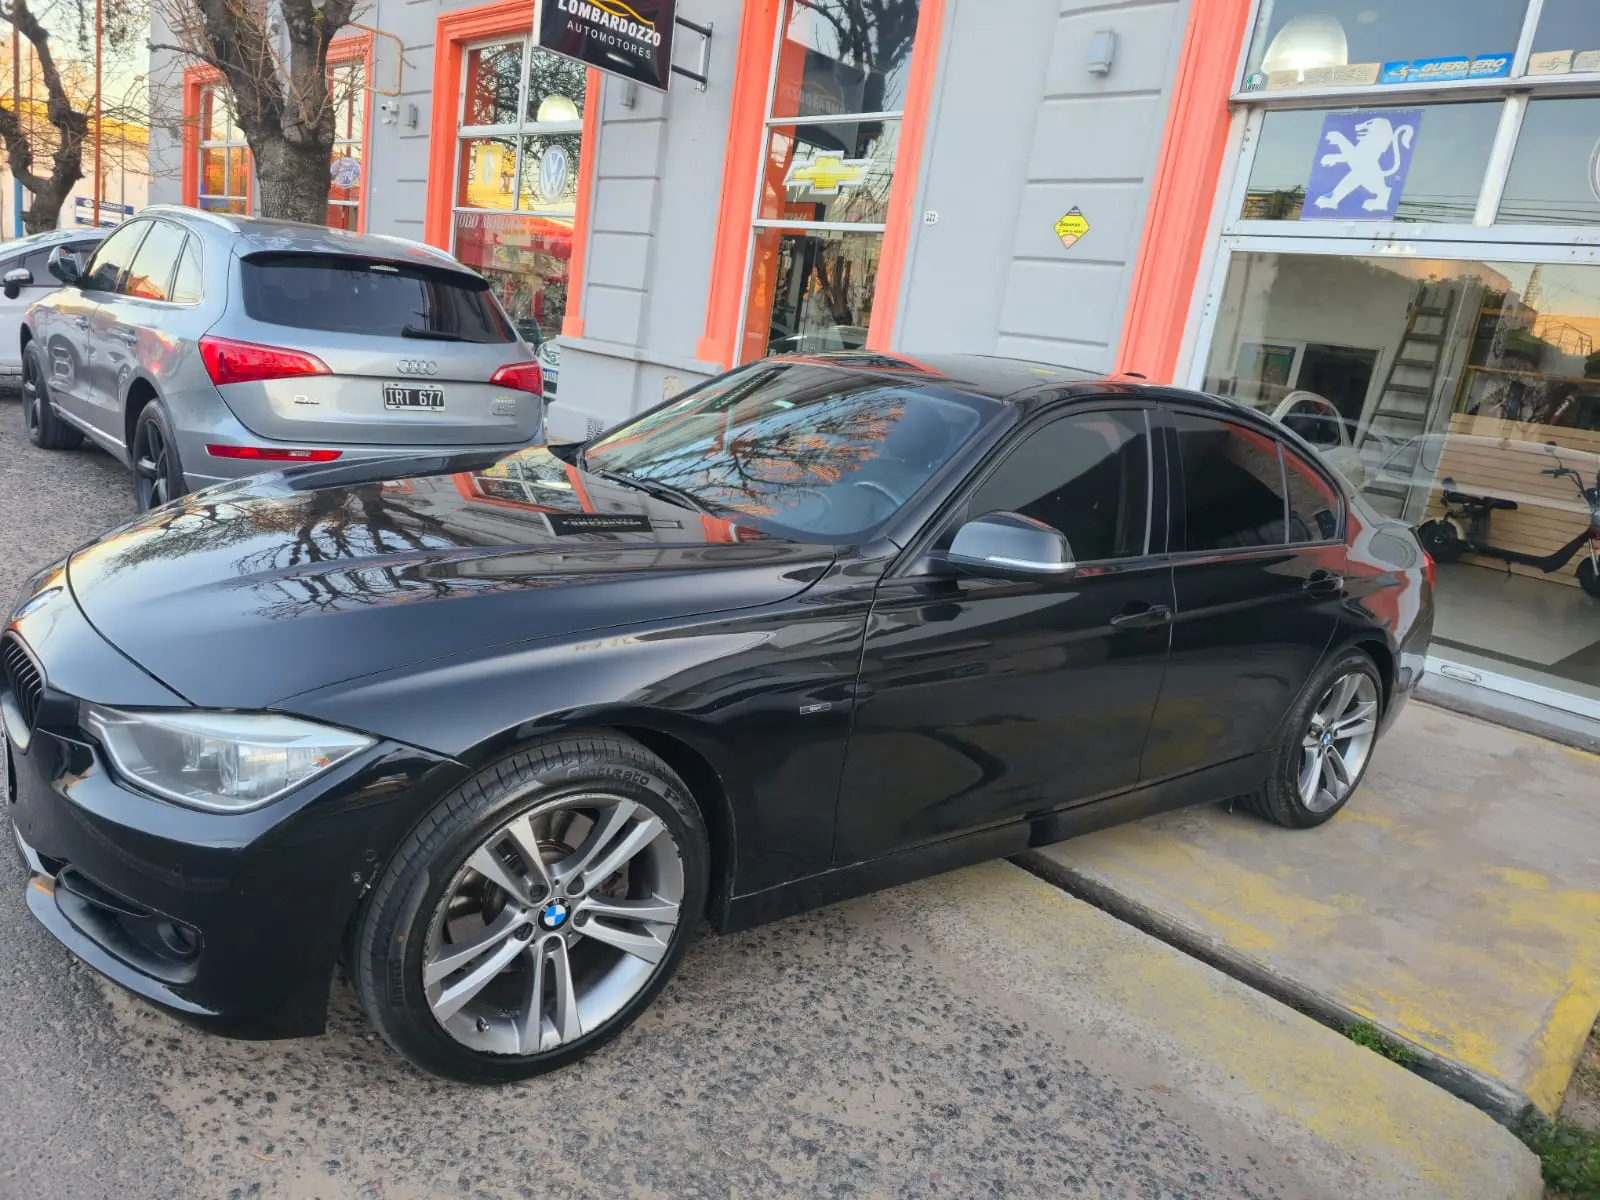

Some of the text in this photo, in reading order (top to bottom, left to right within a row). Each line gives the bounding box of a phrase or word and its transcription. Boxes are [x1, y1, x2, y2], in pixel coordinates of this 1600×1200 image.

[557, 0, 662, 47] LOMBARDOZZO
[566, 19, 652, 60] AUTOMOTORES
[387, 389, 442, 405] IRT 677
